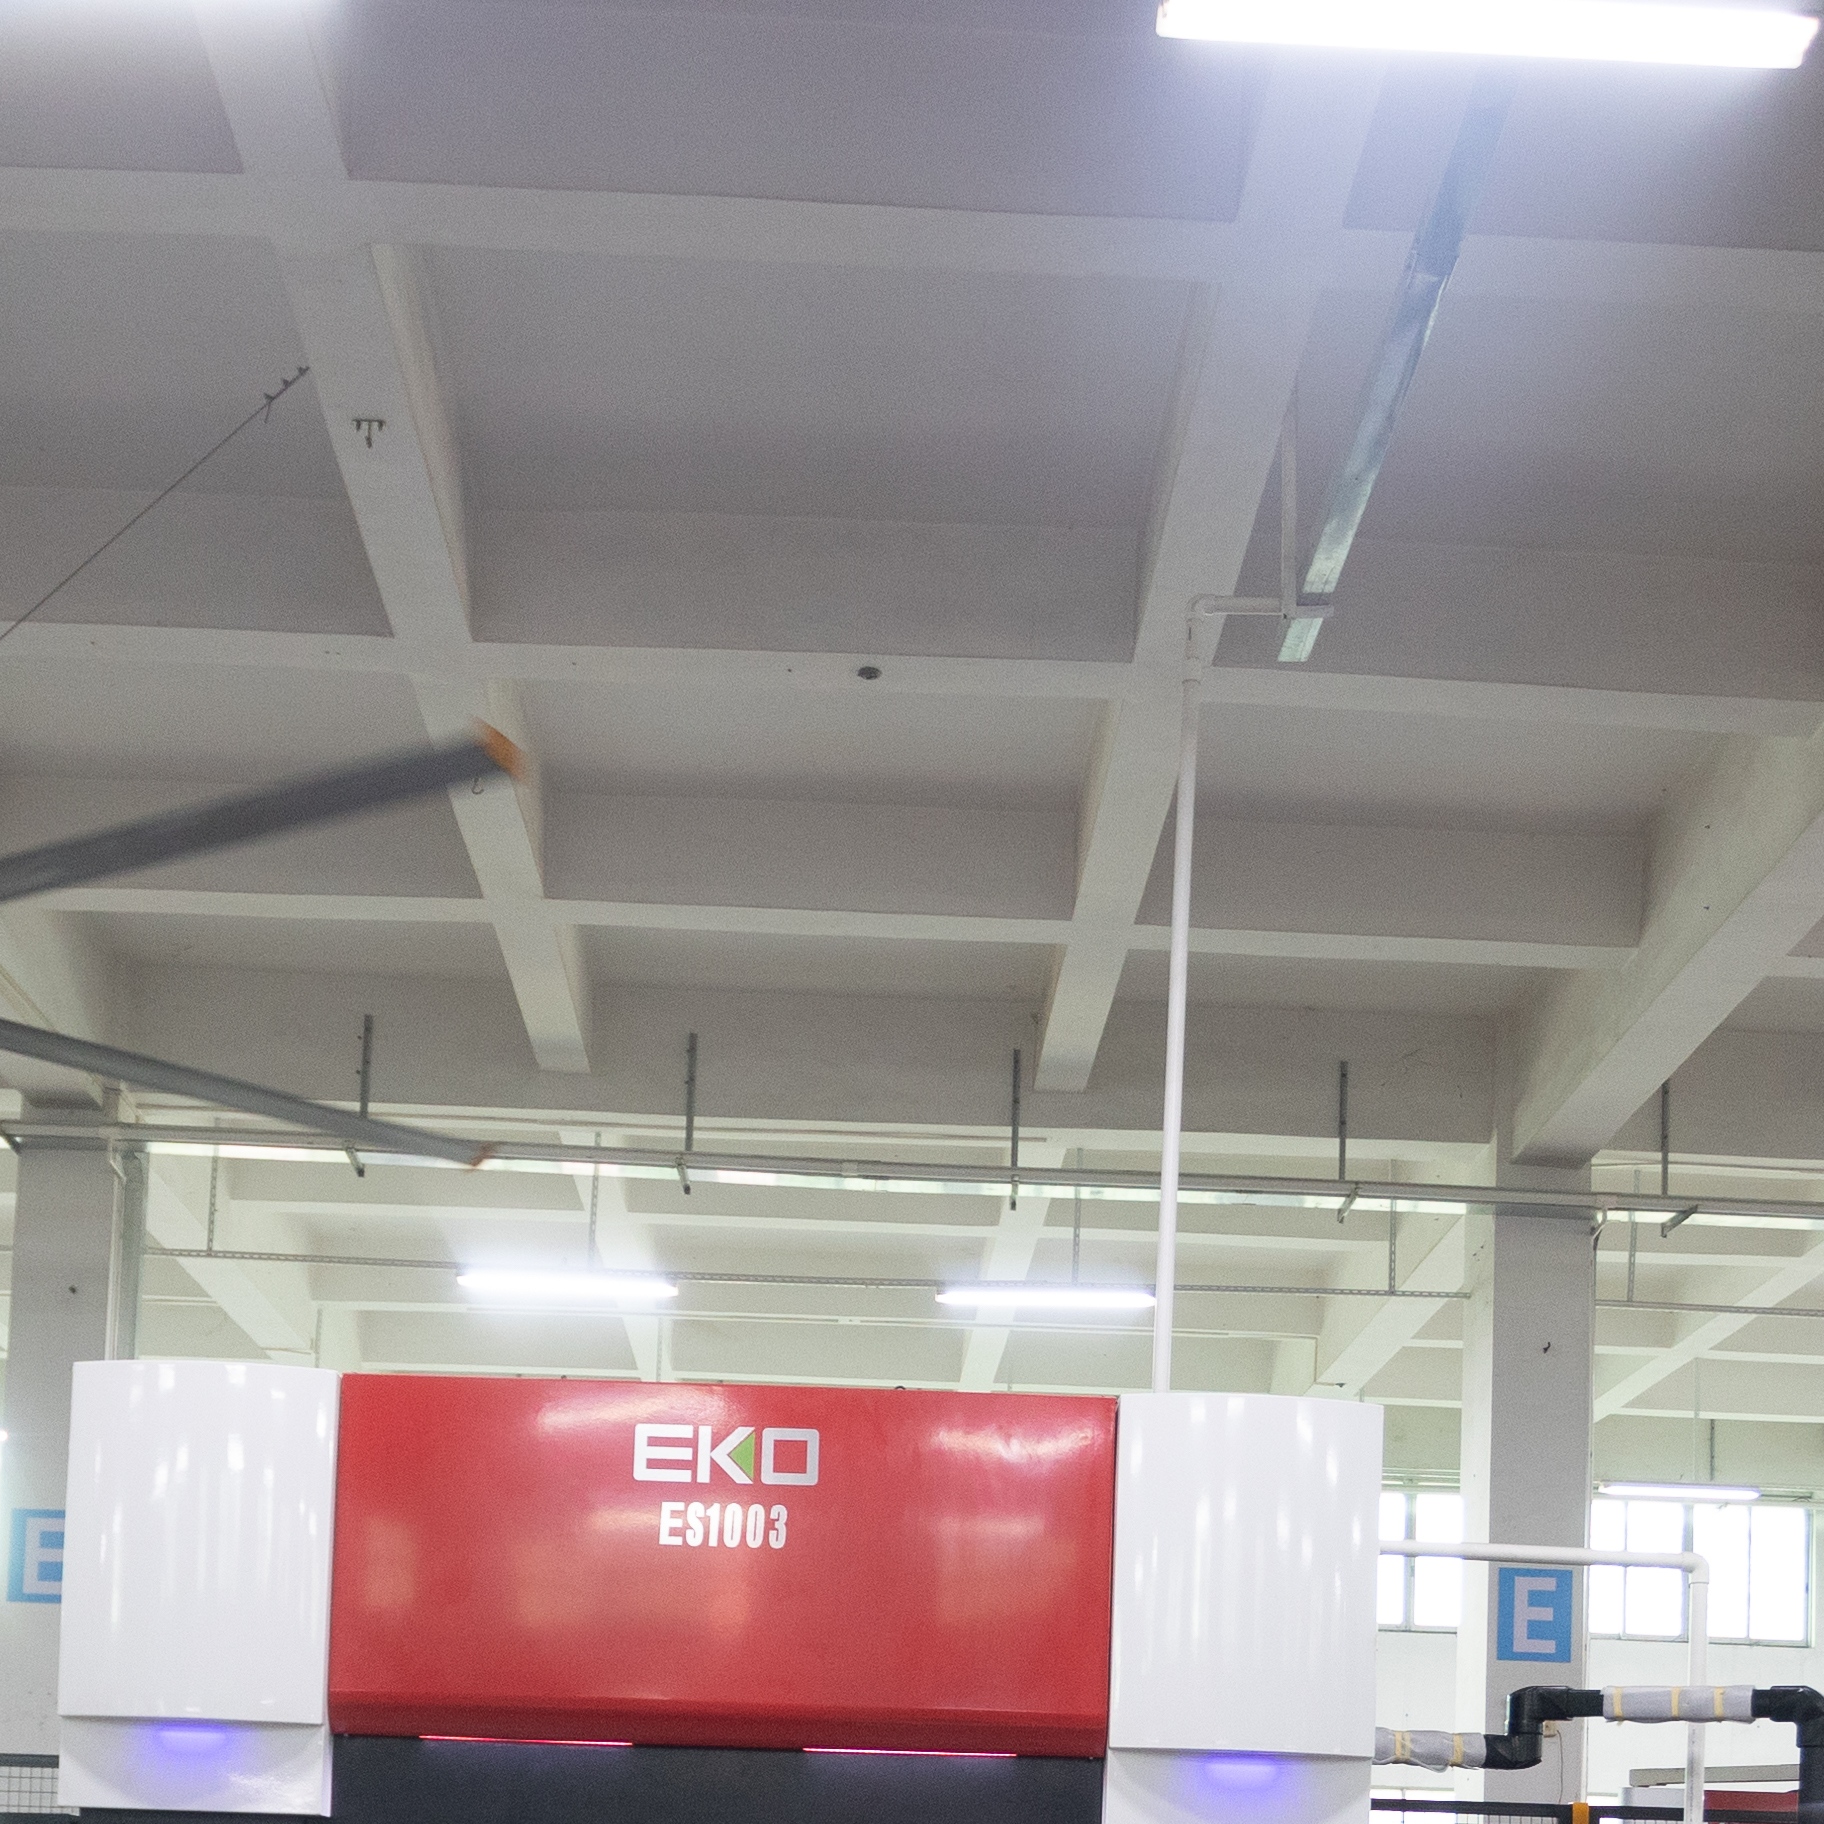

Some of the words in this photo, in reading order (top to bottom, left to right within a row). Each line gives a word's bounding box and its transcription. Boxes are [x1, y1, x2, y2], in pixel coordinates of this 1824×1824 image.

[633, 1423, 820, 1486] EKO
[22, 1518, 65, 1595] E
[658, 1501, 788, 1549] ES1003
[1512, 1576, 1557, 1654] E
